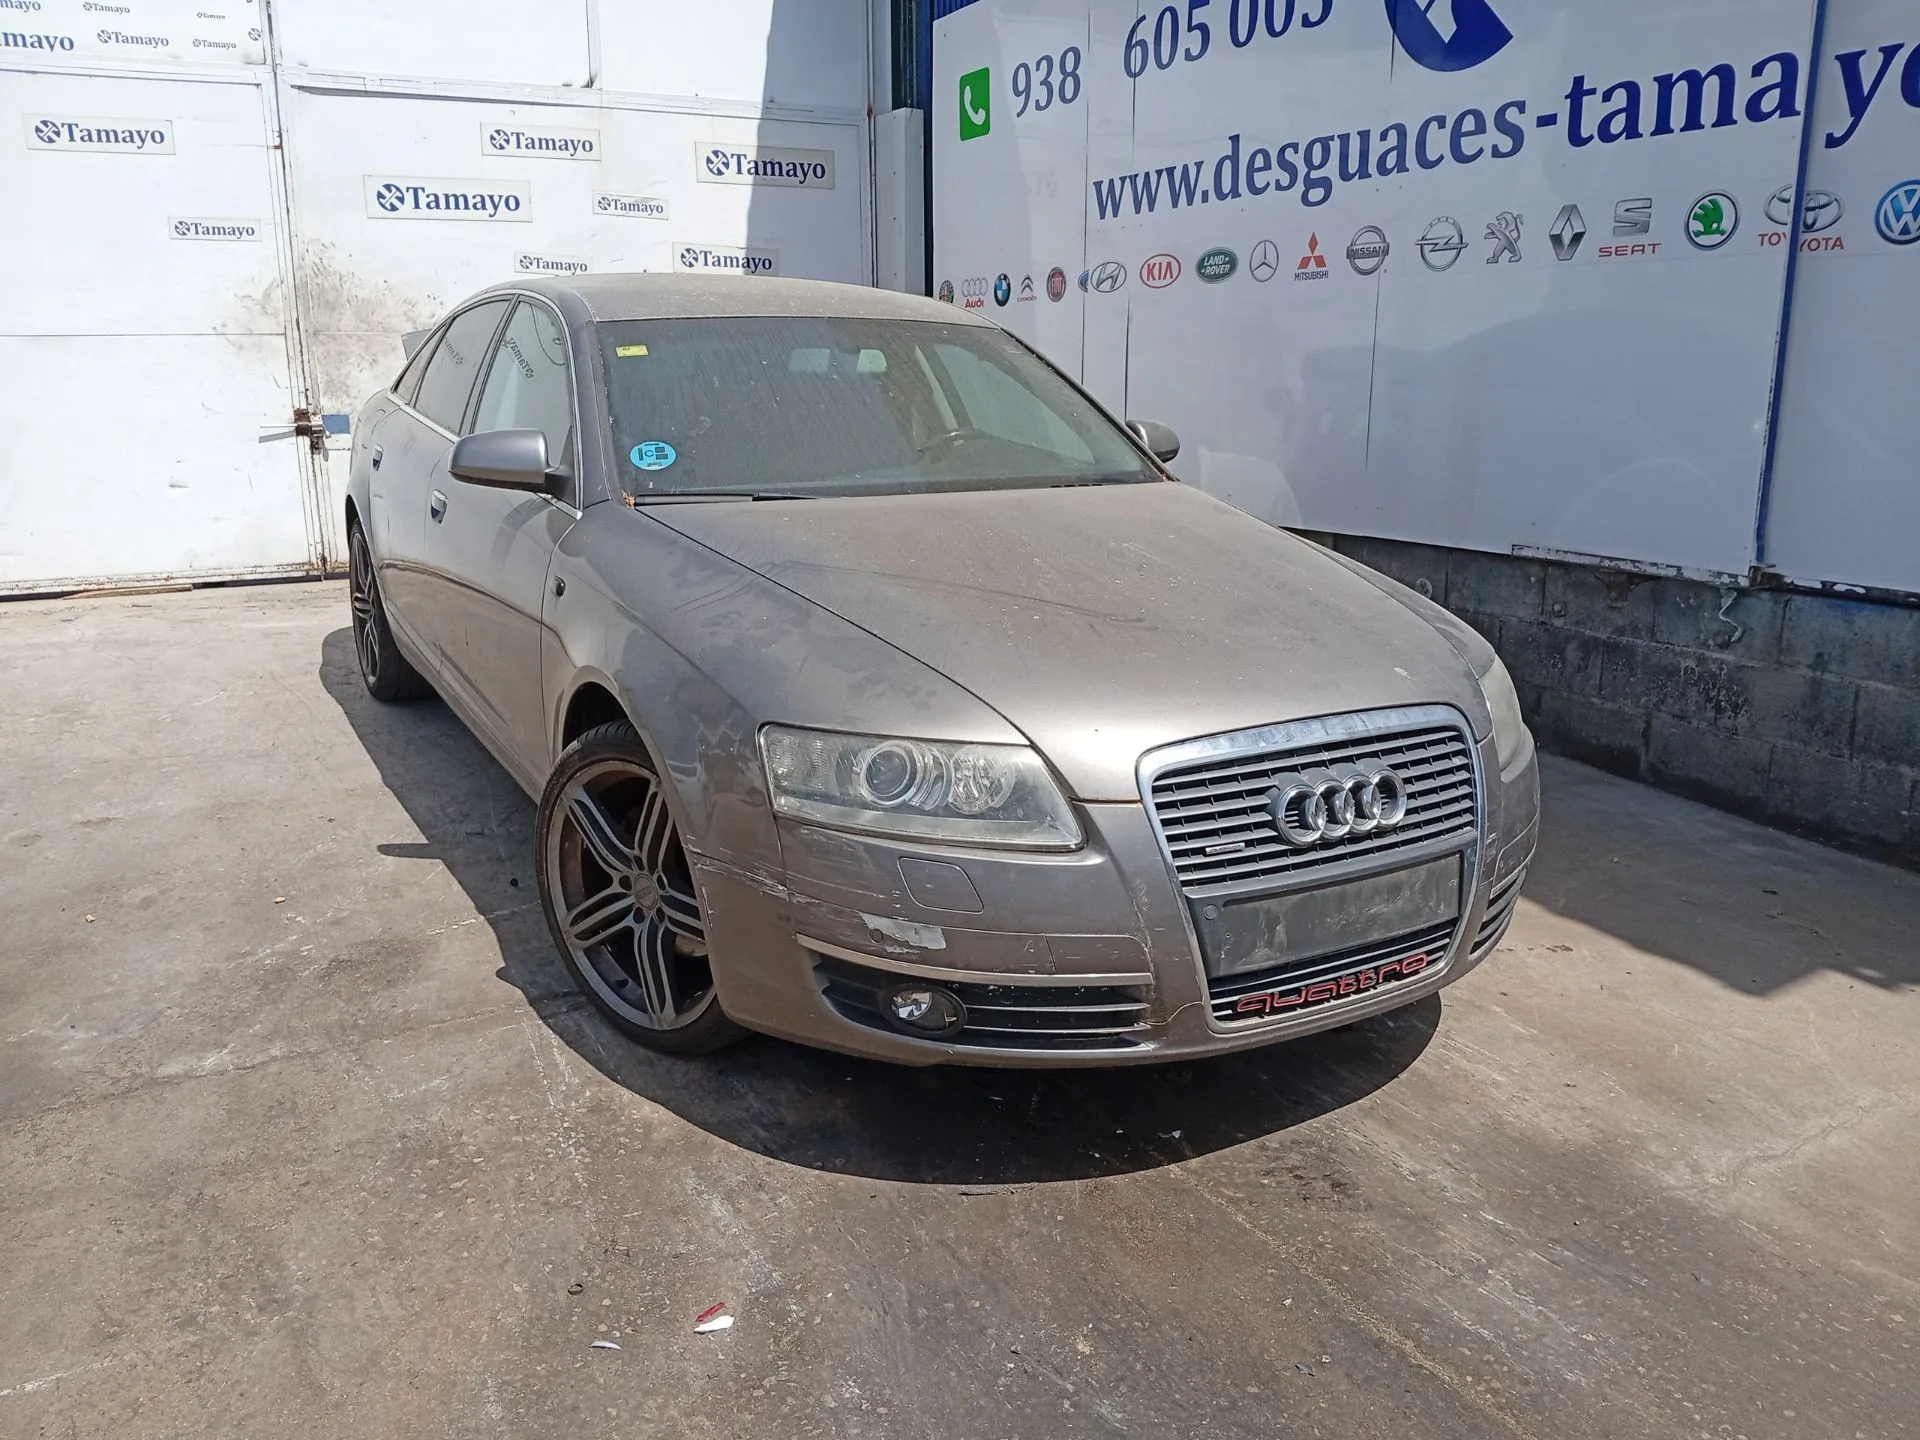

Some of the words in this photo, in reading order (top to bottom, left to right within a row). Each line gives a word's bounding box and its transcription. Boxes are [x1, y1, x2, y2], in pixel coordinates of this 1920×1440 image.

[93, 3, 130, 14] Tamayo
[0, 31, 75, 52] mayo
[111, 31, 169, 48] Tamayo
[201, 39, 237, 50] Tamayo
[1011, 46, 1082, 118] 938
[1123, 0, 1211, 78] 605
[61, 122, 165, 149] Tamayo
[510, 131, 594, 155] Tamayo
[730, 153, 826, 181] Tamayo
[405, 187, 521, 218] Tamayo
[611, 198, 664, 216] Tamayo
[190, 222, 255, 239] Tamayo
[1351, 245, 1385, 257] NISSAN
[1598, 243, 1662, 258] SEAT
[532, 257, 588, 275] Tamayo
[699, 250, 773, 273] Tamayo
[1203, 255, 1224, 266] LAND
[1204, 264, 1231, 275] ROVER
[1146, 261, 1174, 282] KIA
[1294, 270, 1329, 282] MITSUBISHI
[964, 297, 984, 309] Audi
[1237, 953, 1428, 1014] quattro
